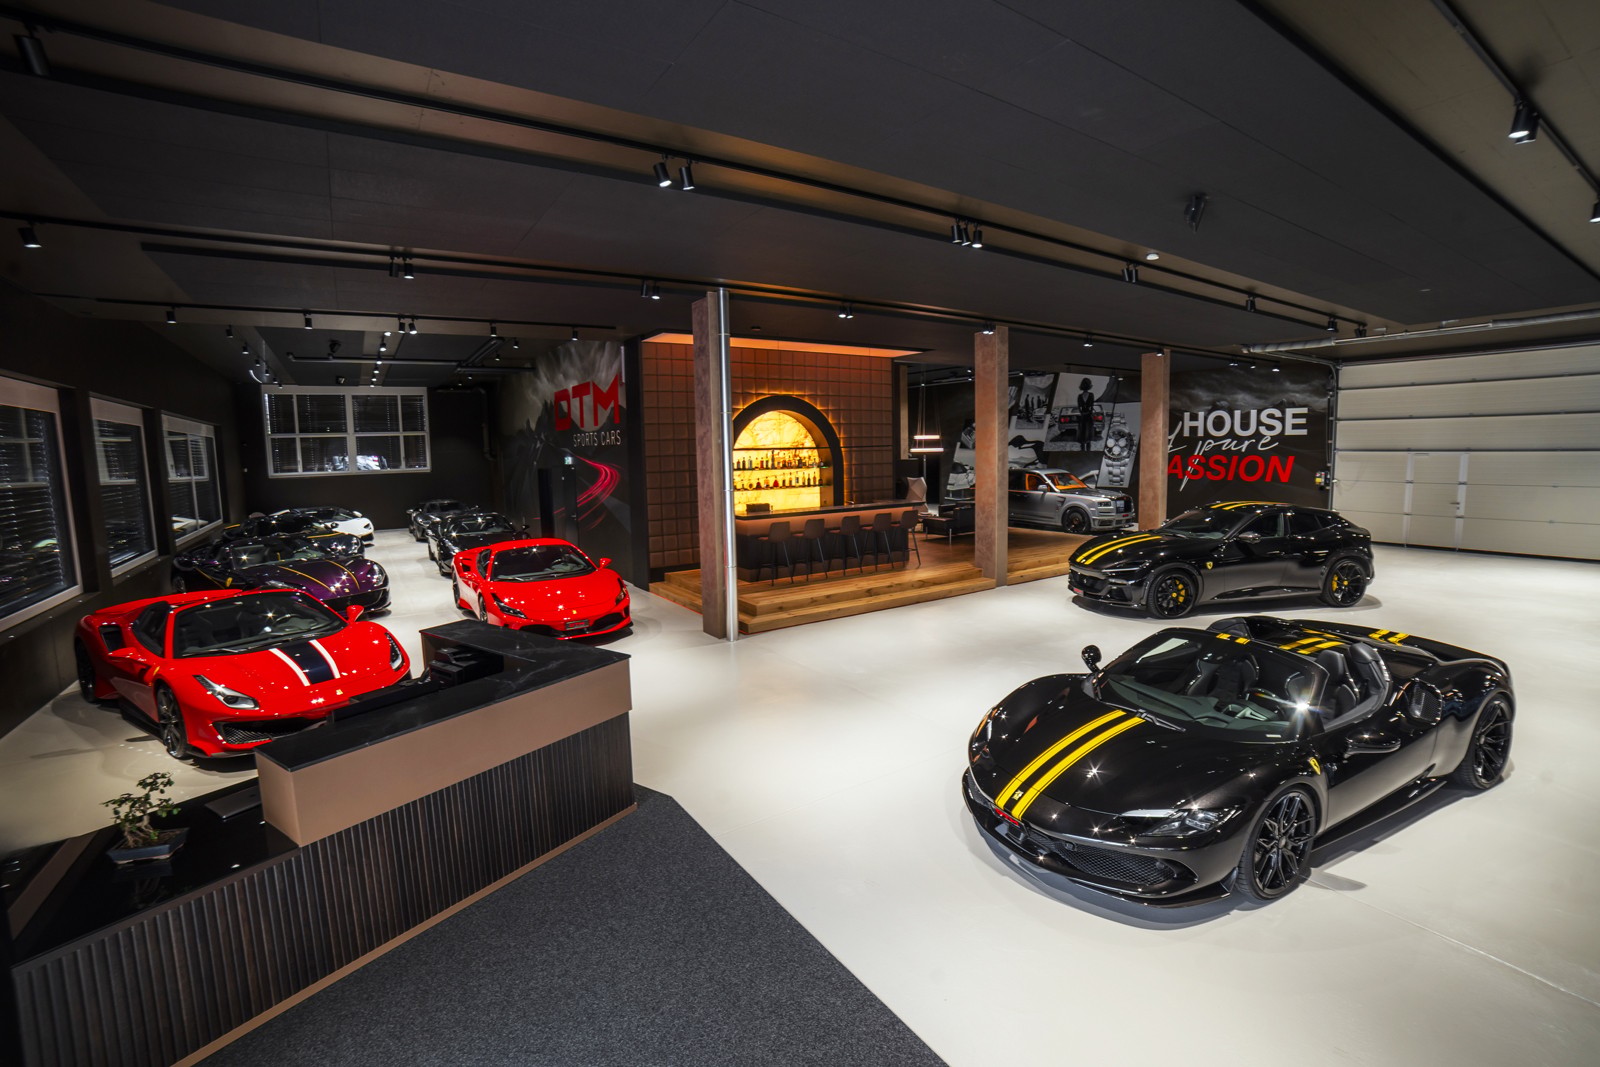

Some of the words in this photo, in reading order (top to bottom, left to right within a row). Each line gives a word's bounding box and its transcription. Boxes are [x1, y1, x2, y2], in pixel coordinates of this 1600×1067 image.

[554, 375, 620, 431] DTM
[1183, 407, 1308, 436] HOUSE
[573, 433, 598, 447] SPORTS
[601, 430, 621, 445] CARS
[1167, 455, 1295, 483] ASSION
[1180, 435, 1279, 491] pure
